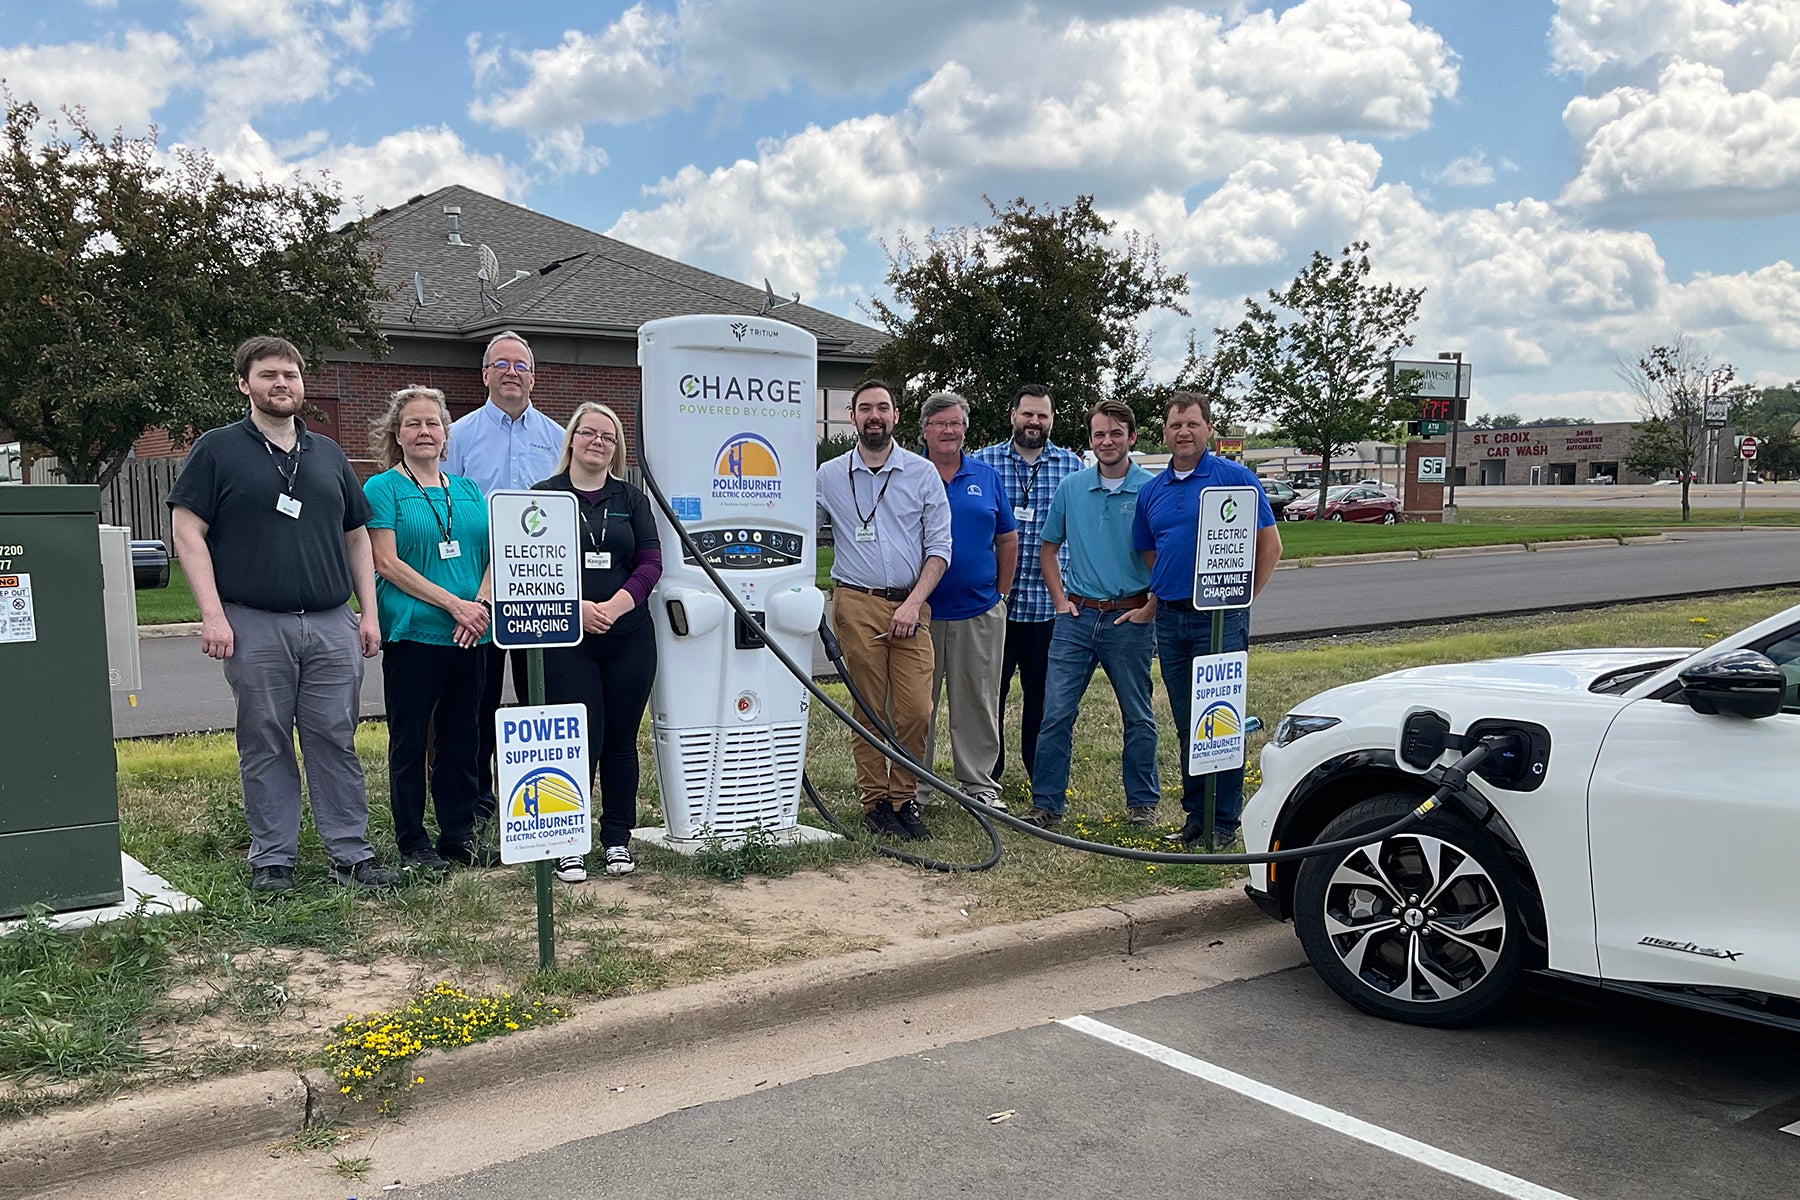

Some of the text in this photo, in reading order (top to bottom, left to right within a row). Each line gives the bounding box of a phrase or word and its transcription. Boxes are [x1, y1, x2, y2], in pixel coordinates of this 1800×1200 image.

[750, 329, 779, 338] TRITIUM
[679, 374, 802, 404] CHARGE
[679, 404, 802, 418] POWERED BY CO-OPS
[1473, 432, 1530, 445] ST. CROIX
[1565, 436, 1604, 444] TOUCHLESS
[1487, 446, 1548, 458] CAR WASH
[713, 478, 782, 491] POLK BURNETT
[712, 490, 782, 499] ELECTRIC COOPERATIVE
[1207, 528, 1248, 540] ELECTRIC
[504, 545, 567, 559] ELECTRIC
[1209, 543, 1244, 555] VEHICLE
[509, 563, 563, 577] VEHICLE
[1206, 558, 1244, 570] PARKING
[1201, 573, 1248, 586] ONLY WHILE
[11, 589, 26, 597] OUT
[509, 582, 565, 596] PARKING
[1203, 586, 1245, 599] CHARGING
[502, 603, 573, 617] ONLY WHILE
[507, 619, 569, 633] CHARGING
[1196, 661, 1242, 684] POWER
[1196, 684, 1242, 700] SUPPLIED BY
[504, 716, 580, 744] POWER
[1193, 736, 1241, 752] POLK BURNETT
[505, 745, 581, 764] SUPPLIED BY
[1192, 746, 1241, 759] ELECTRIC COOPERATIVE
[506, 813, 585, 833] POLK BURNETT
[506, 826, 585, 842] ELECTRIC COOPERATIVE
